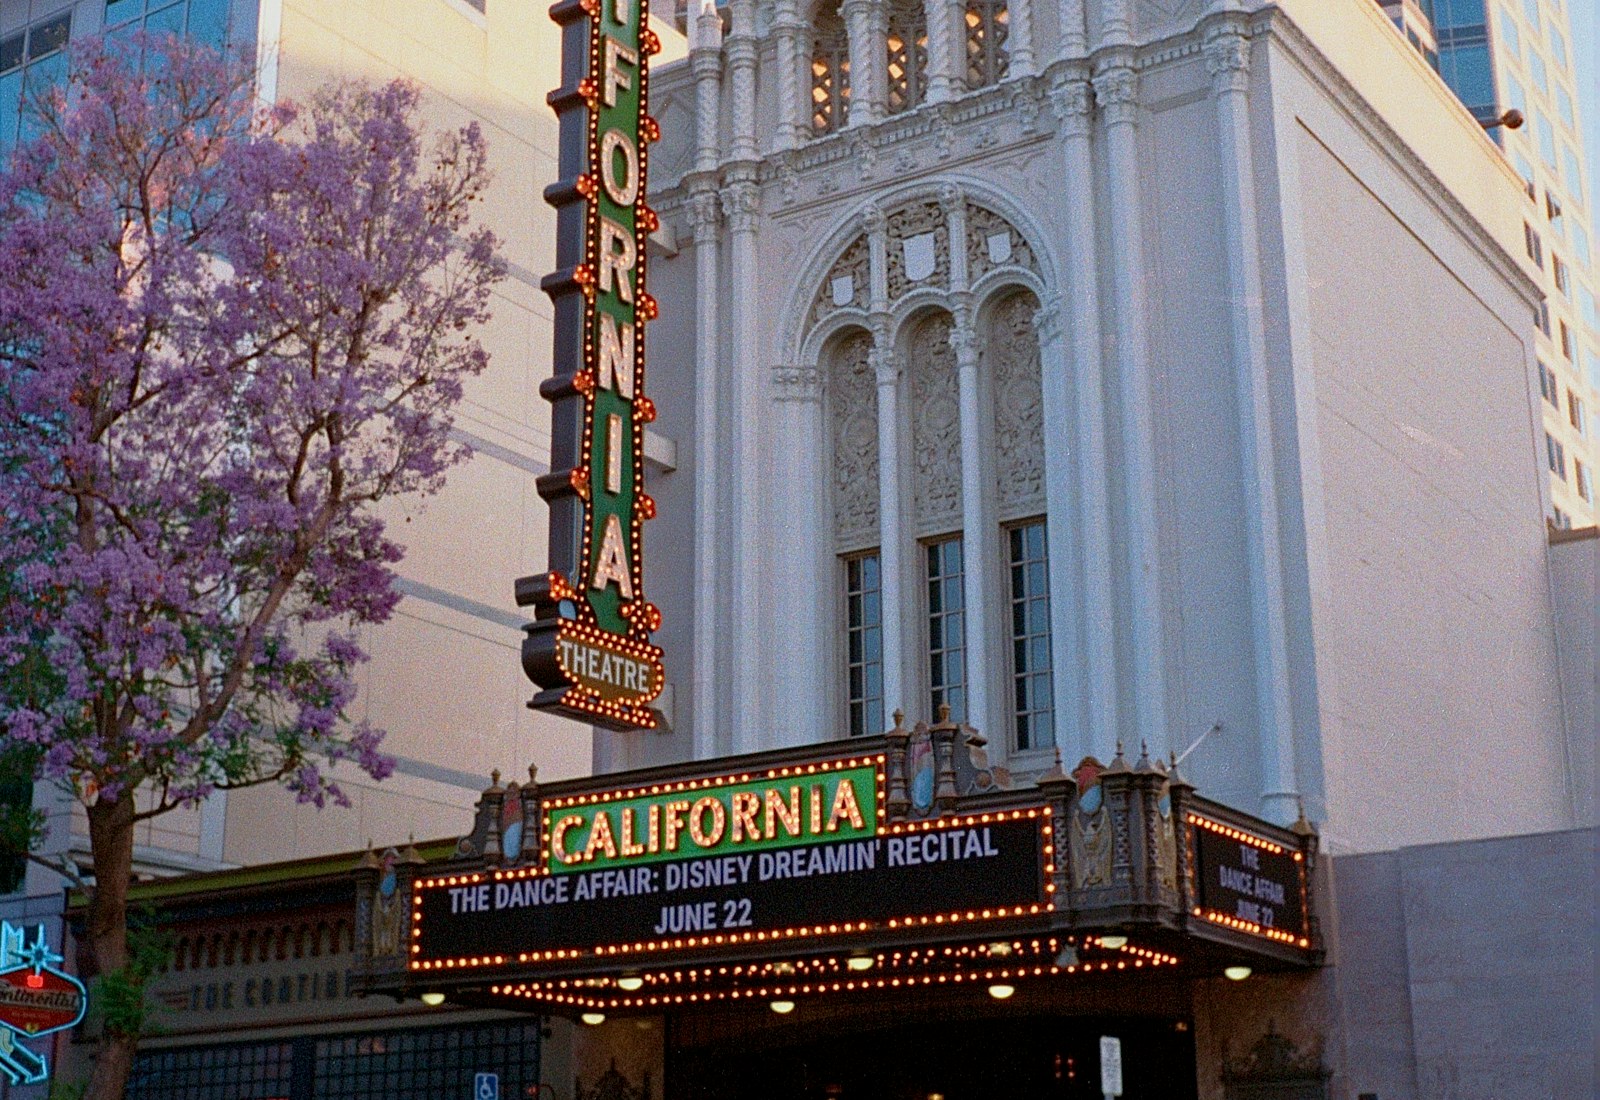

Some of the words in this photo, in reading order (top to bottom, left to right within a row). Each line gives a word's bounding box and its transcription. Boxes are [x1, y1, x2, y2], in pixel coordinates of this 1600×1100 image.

[559, 640, 650, 693] THEATRE
[552, 778, 865, 864] CALIFORNIA
[448, 886, 490, 914] THE
[495, 877, 568, 910] DANCE
[574, 866, 660, 901] AFFAIR:
[665, 854, 753, 891] DISNEY
[758, 839, 881, 882] DREAMIN'
[887, 827, 999, 867] RECITAL
[655, 902, 718, 935] JUNE
[723, 899, 753, 928] 22
